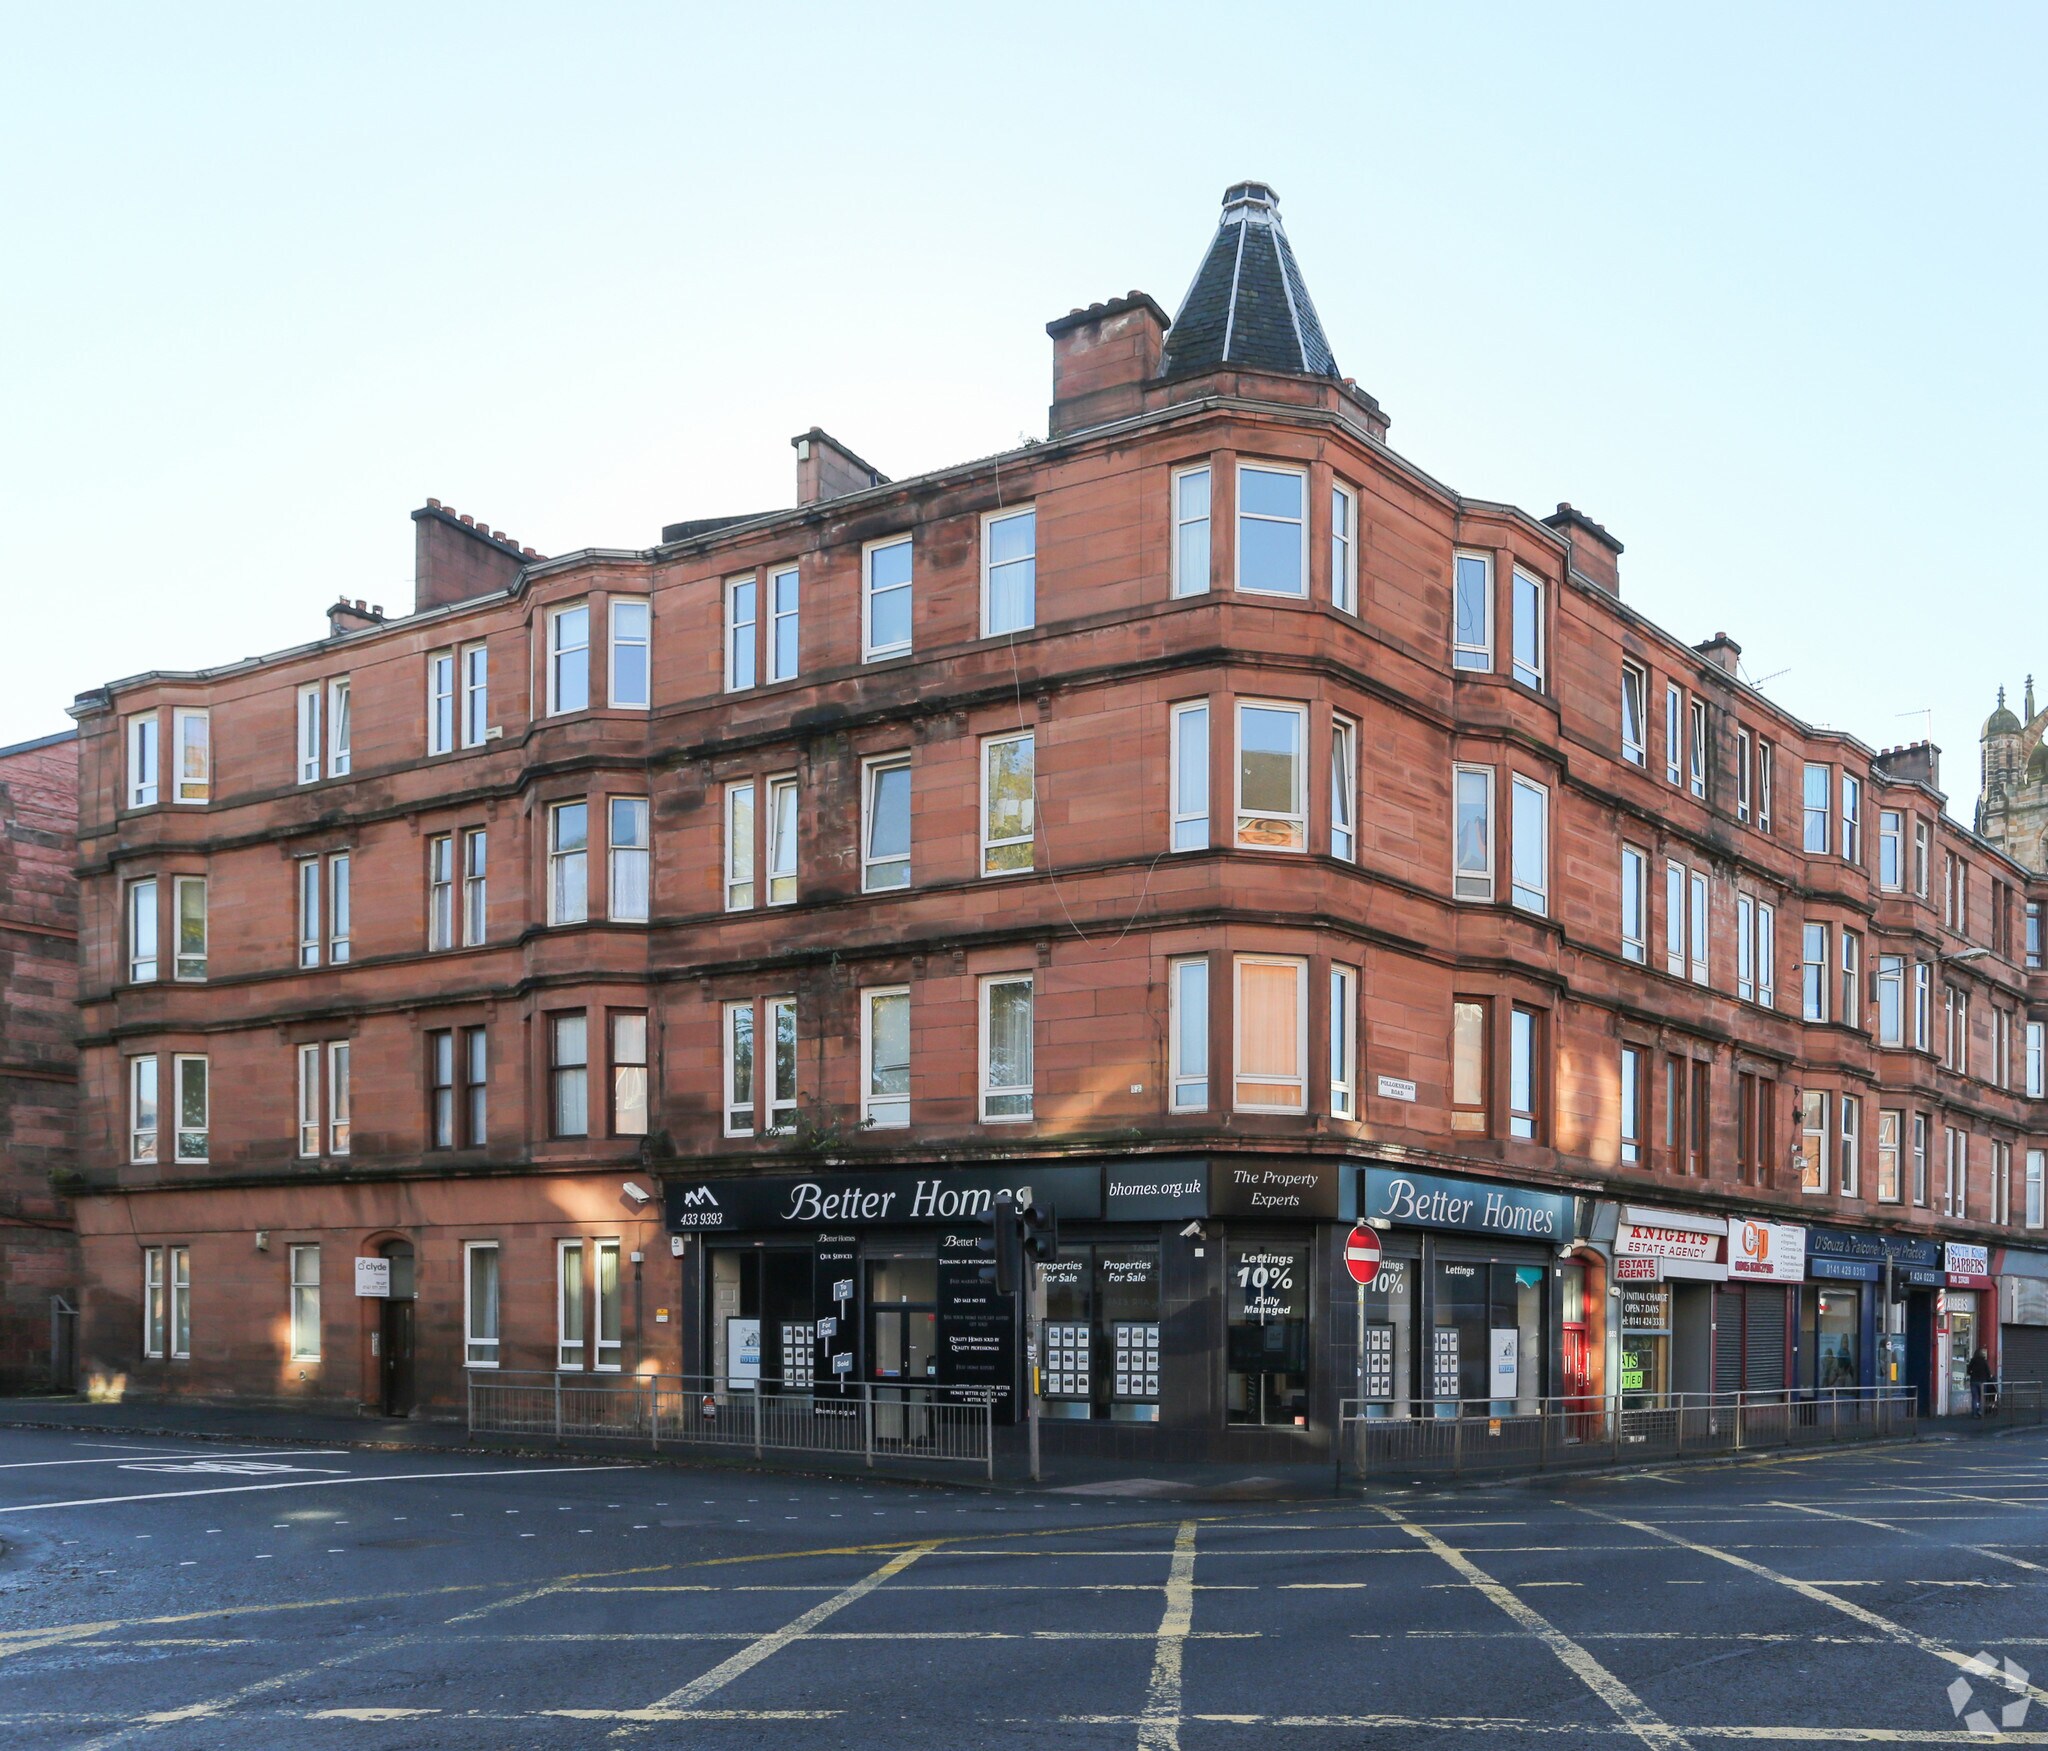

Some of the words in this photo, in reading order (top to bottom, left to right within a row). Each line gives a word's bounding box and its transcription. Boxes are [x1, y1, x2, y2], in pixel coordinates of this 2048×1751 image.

[1233, 1171, 1259, 1184] The
[1263, 1171, 1319, 1187] Property
[1109, 1180, 1201, 1197] bhomes.org.uk
[780, 1183, 897, 1220] Better
[1251, 1192, 1300, 1208] Experts
[1379, 1179, 1473, 1224] Better
[1482, 1192, 1554, 1234] Homes
[680, 1213, 698, 1225] 433
[699, 1213, 723, 1225] 9393
[942, 1235, 974, 1247] Better
[1630, 1226, 1710, 1245] KNIGHTS
[1628, 1242, 1665, 1254] ESTATE
[1668, 1246, 1706, 1258] AGENCY
[1815, 1236, 1844, 1252] D'Souza
[1901, 1245, 1927, 1259] Practice
[1241, 1253, 1294, 1266] Lettings
[1618, 1260, 1654, 1268] ESTATE
[1952, 1257, 1984, 1273] BARBERS
[366, 1262, 387, 1272] clyde
[1037, 1261, 1083, 1272] Properties
[1103, 1260, 1151, 1272] Properties
[1379, 1260, 1404, 1272] ttings
[1445, 1265, 1475, 1277] Lettings
[1826, 1264, 1840, 1274] 0141
[1042, 1273, 1057, 1282] For
[1059, 1273, 1078, 1283] Sale
[1108, 1272, 1125, 1282] For
[1126, 1272, 1146, 1282] Sale
[1237, 1266, 1293, 1289] 10%
[1617, 1269, 1655, 1278] AGENTS
[1371, 1272, 1404, 1294] 10%
[1254, 1296, 1280, 1306] Fully
[1626, 1292, 1645, 1301] INITIAL
[1646, 1292, 1669, 1302] CHARGE
[1243, 1305, 1291, 1315] Managed
[1625, 1303, 1640, 1312] OPEN
[1640, 1304, 1645, 1313] 7
[1645, 1304, 1659, 1313] DAYS
[1946, 1297, 1968, 1311] ARBERS
[1629, 1317, 1642, 1325] 0141
[1642, 1317, 1652, 1326] 424
